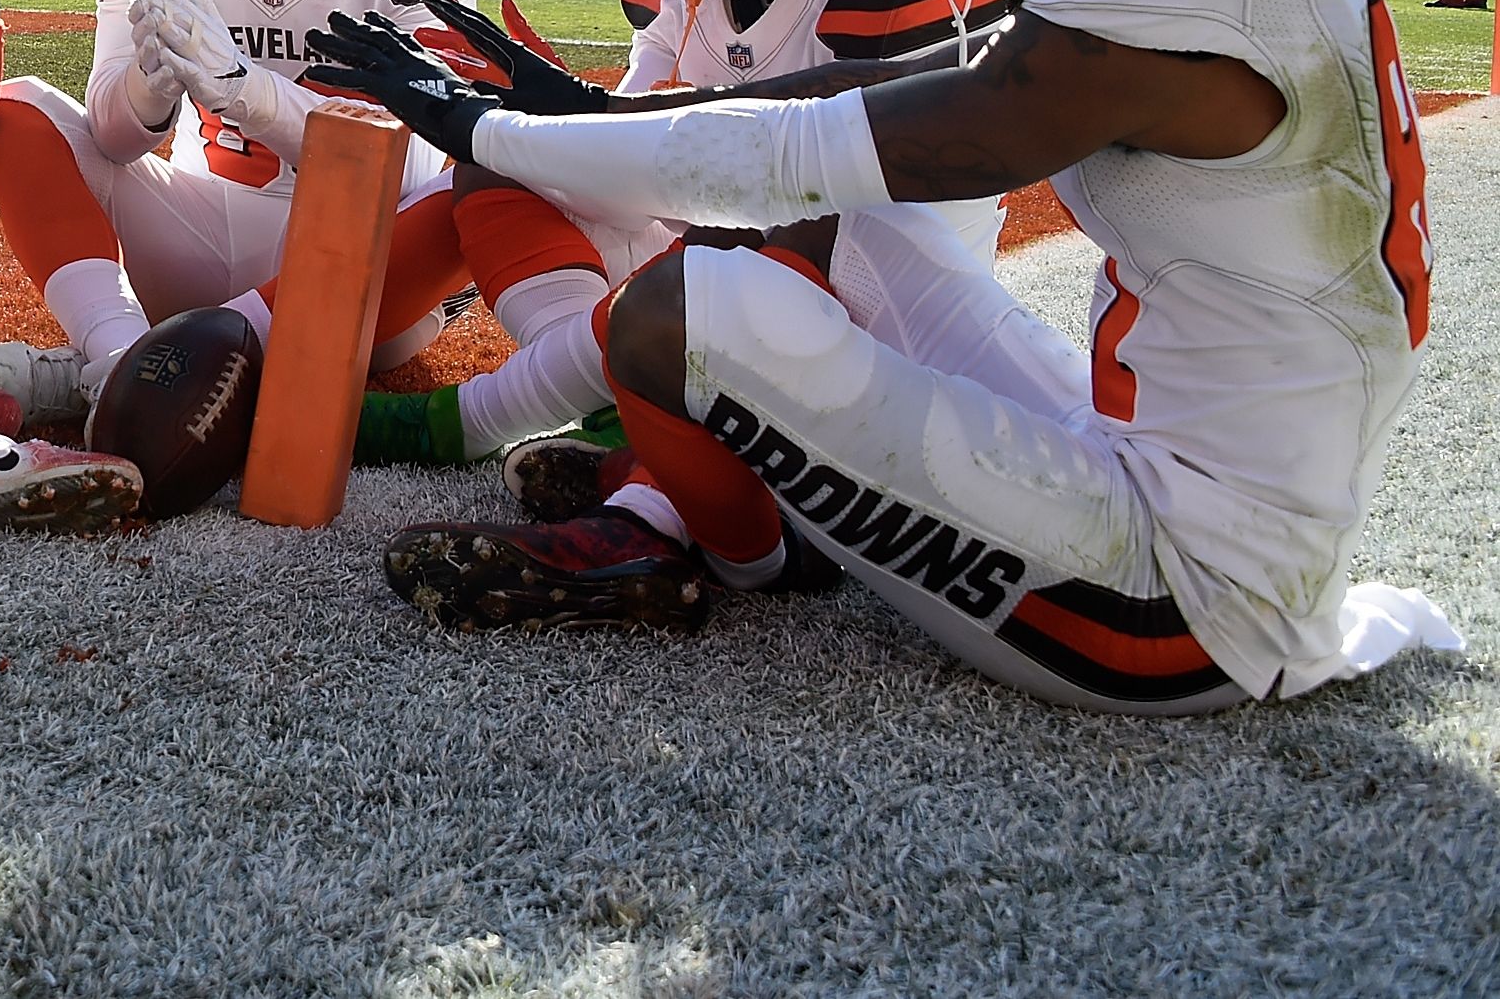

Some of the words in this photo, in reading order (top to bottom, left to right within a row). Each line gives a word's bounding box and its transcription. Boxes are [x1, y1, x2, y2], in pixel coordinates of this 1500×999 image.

[731, 55, 750, 67] NFL
[408, 80, 450, 101] adidas
[705, 393, 1026, 619] BROWNS
